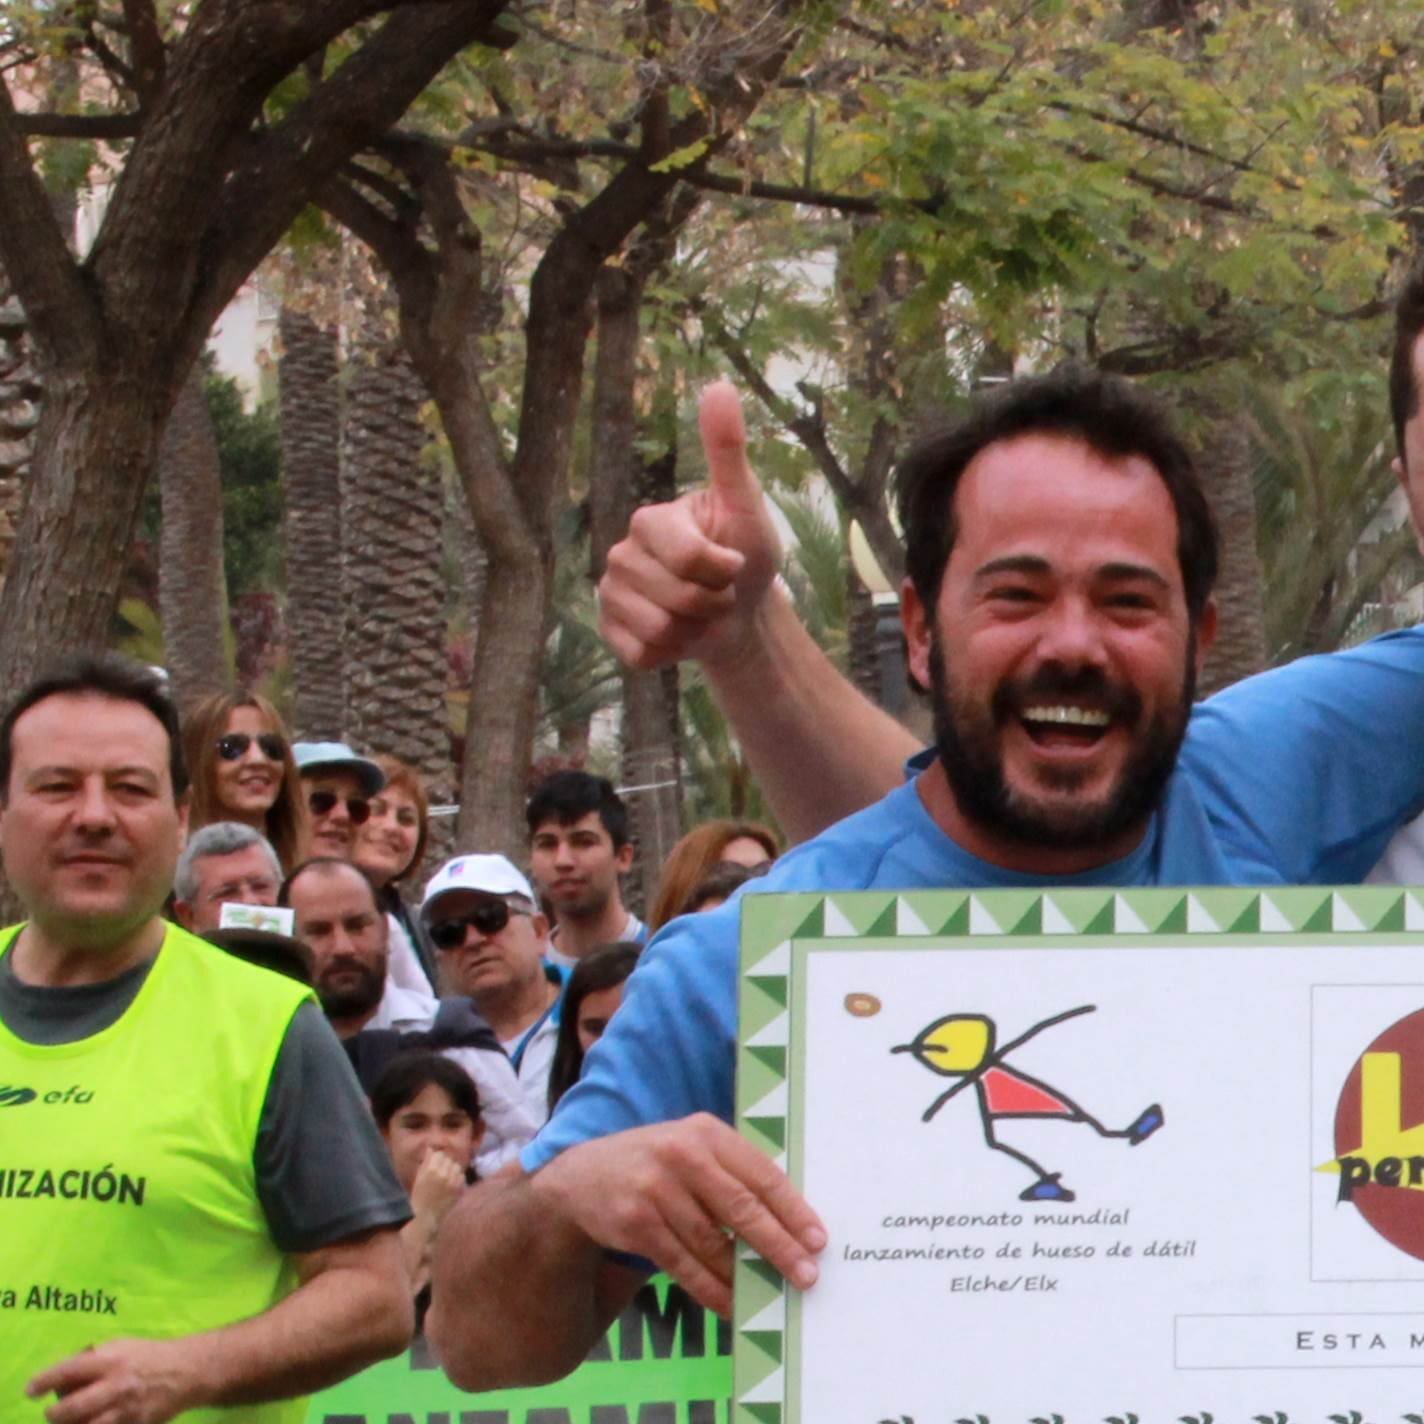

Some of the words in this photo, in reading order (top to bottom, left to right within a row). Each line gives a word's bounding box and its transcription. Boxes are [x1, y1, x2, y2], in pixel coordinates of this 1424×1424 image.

[43, 1085, 96, 1104] efa
[0, 1162, 146, 1206] IZACIÓN
[881, 1212, 1024, 1232] campeonato
[1033, 1208, 1131, 1227] mundial
[843, 1243, 986, 1262] lanzamiento
[995, 1242, 1023, 1259] de
[1031, 1241, 1097, 1260] hueso
[1105, 1241, 1133, 1258] de
[1142, 1239, 1198, 1258] dátil
[949, 1274, 1059, 1294] Elche/Elx
[24, 1284, 118, 1316] Altabix
[1295, 1330, 1388, 1352] ESTA
